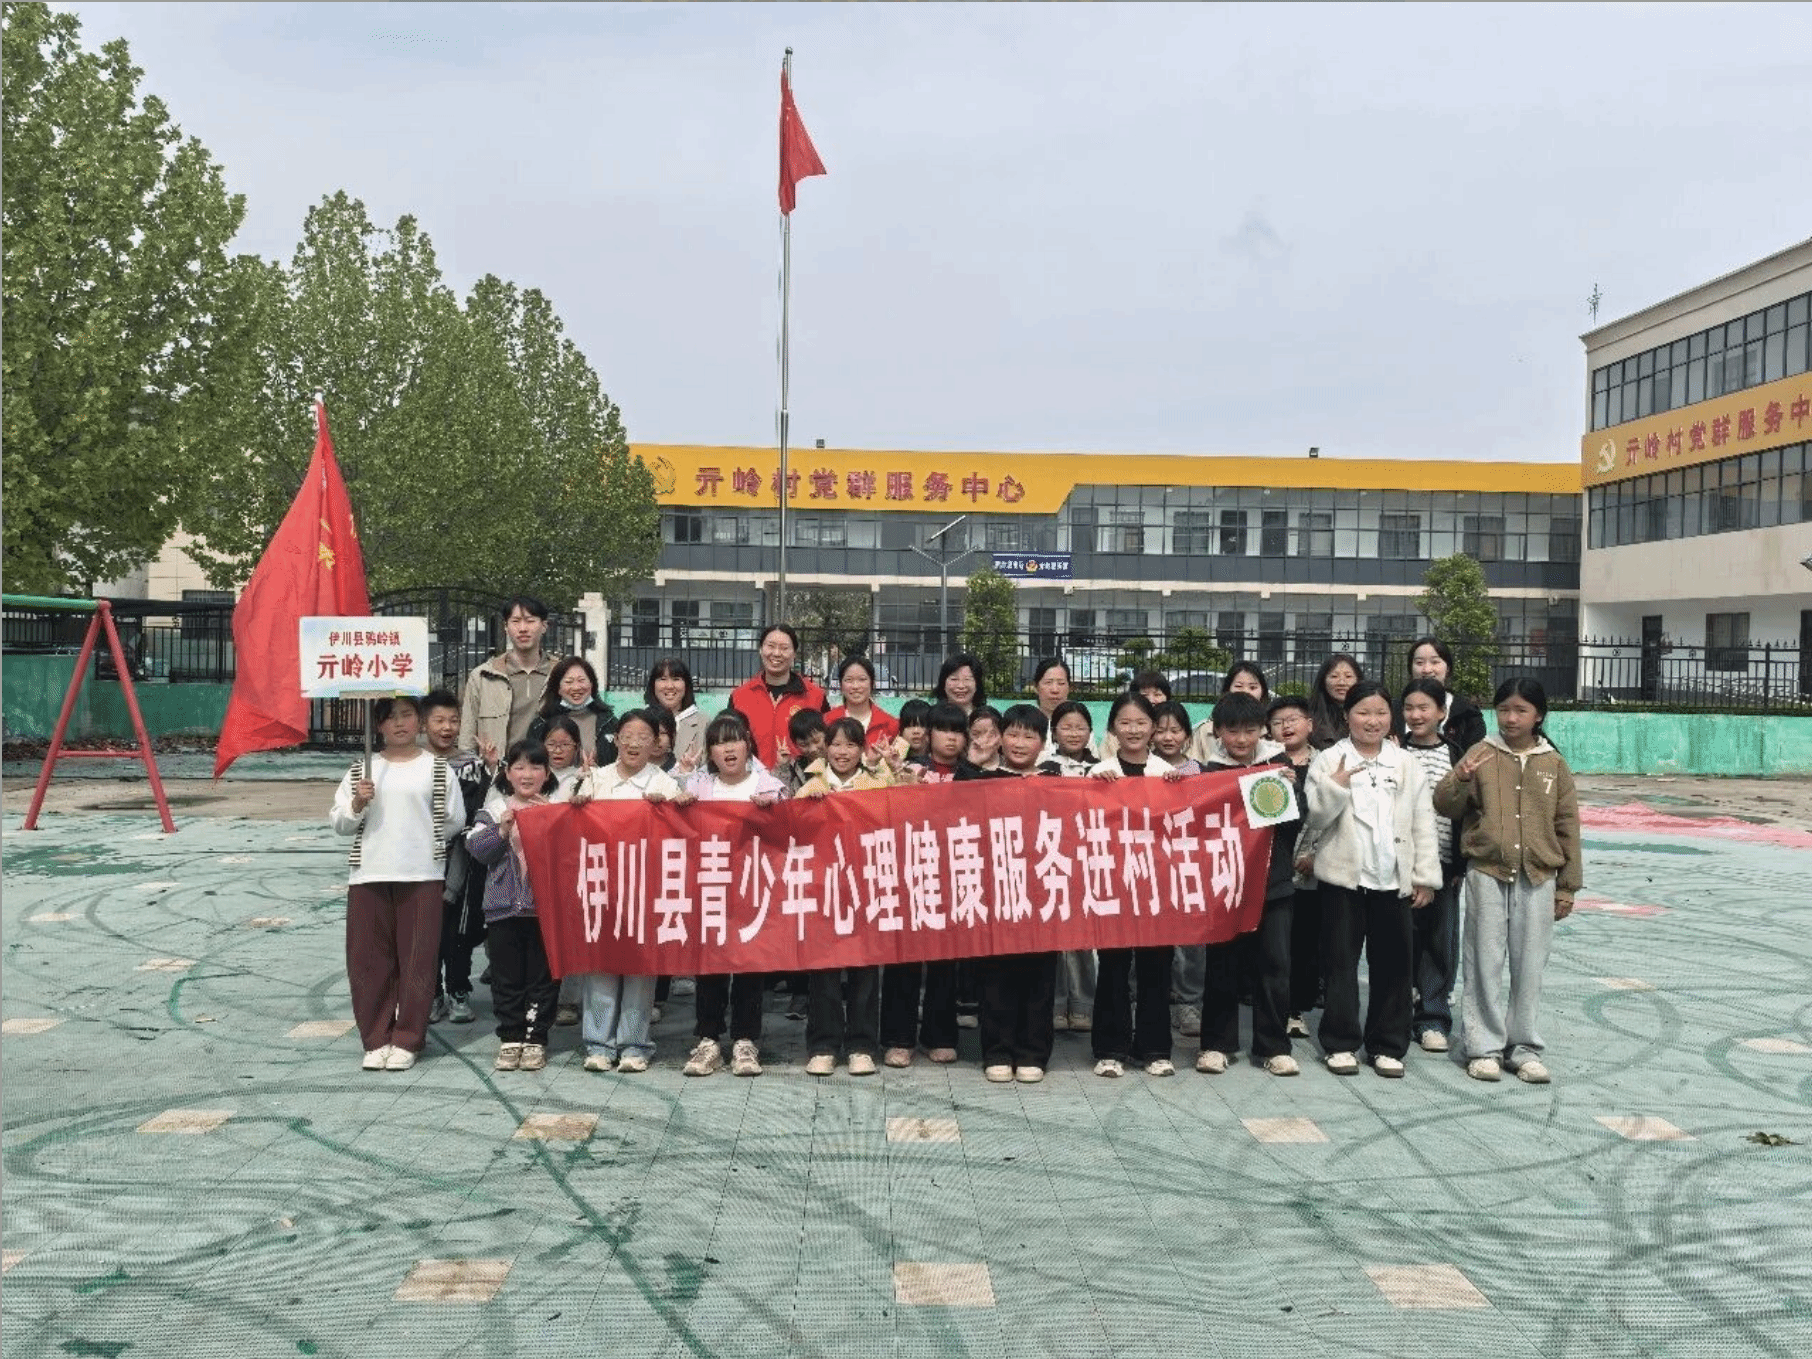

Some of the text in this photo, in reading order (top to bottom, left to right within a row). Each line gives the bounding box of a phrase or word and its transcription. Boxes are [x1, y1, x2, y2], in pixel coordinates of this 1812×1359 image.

[329, 631, 401, 647] 伊川县鸦岭镇
[317, 653, 413, 679] 亓岭小学
[576, 802, 1245, 946] 伊川县青少年心理健康服务进村活动
